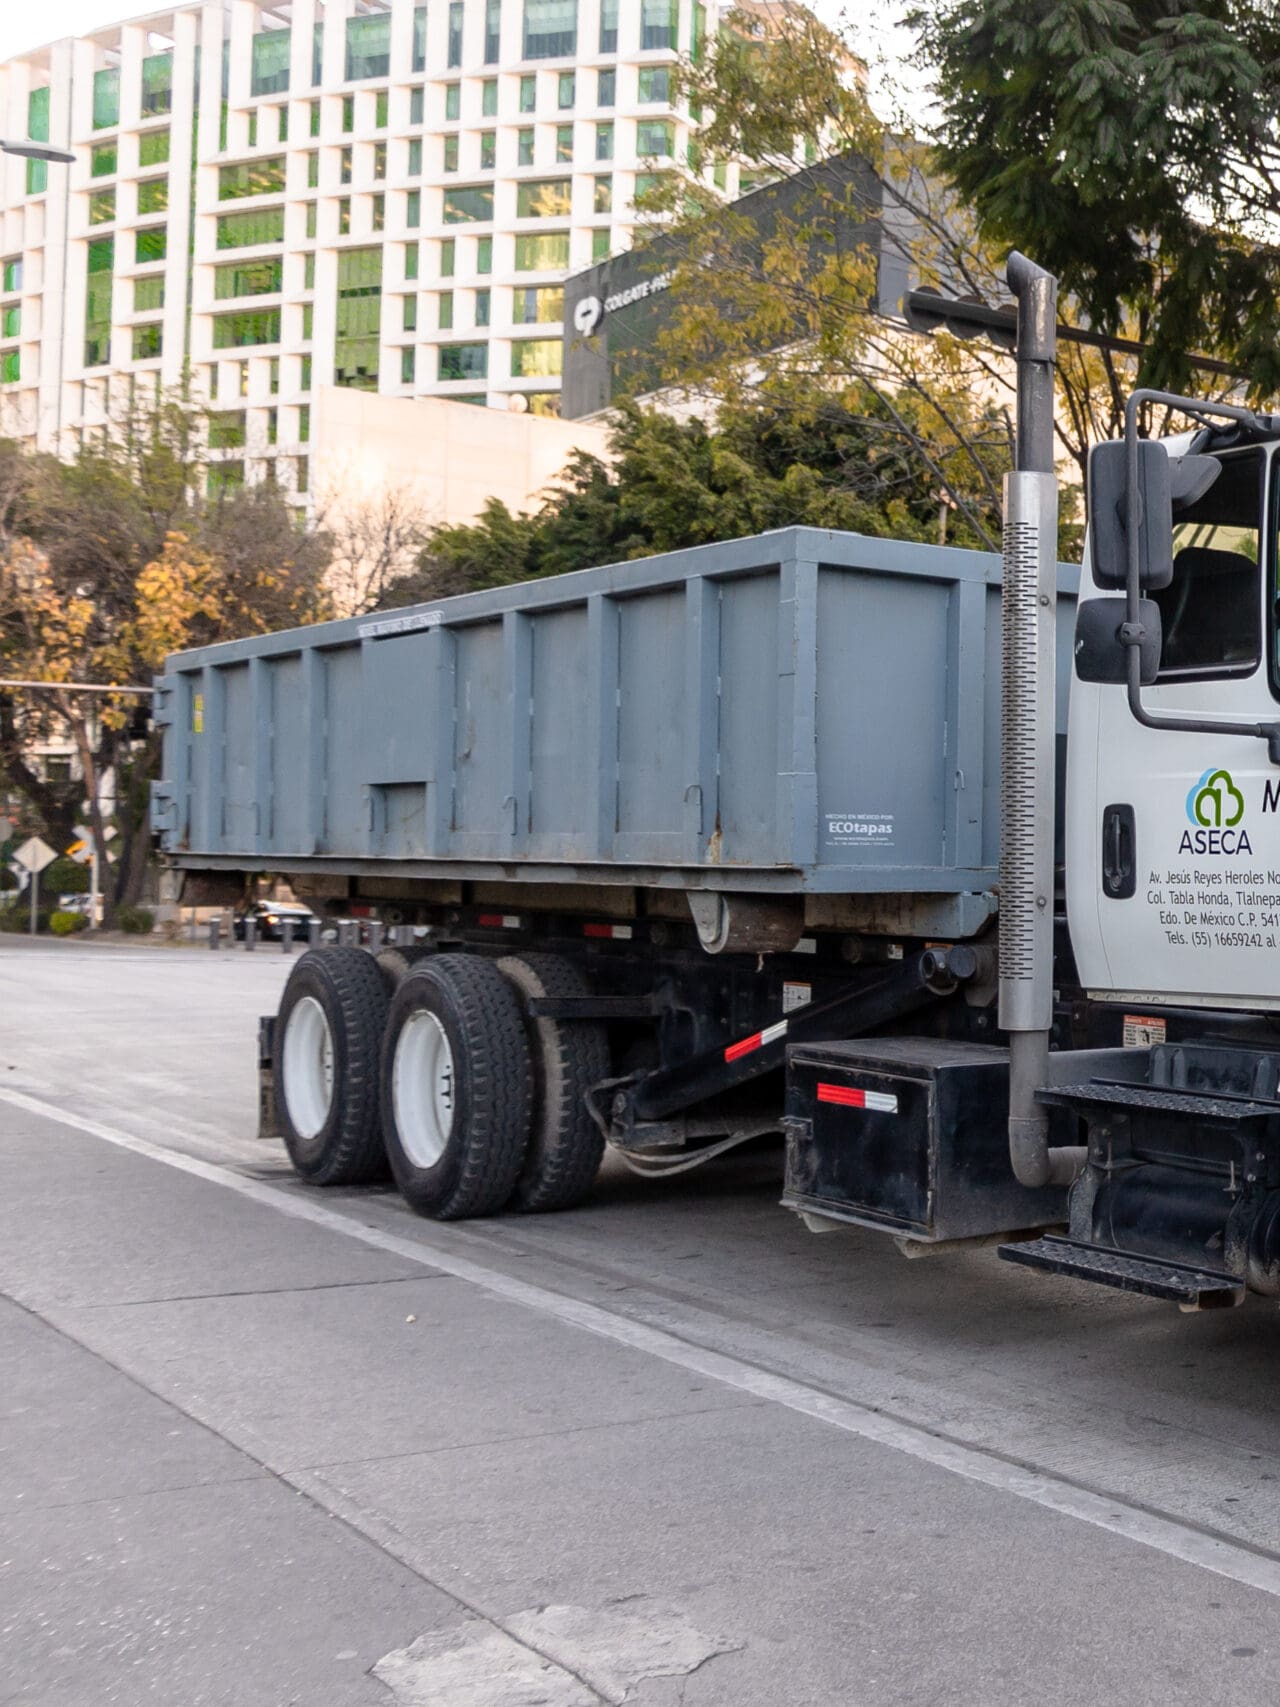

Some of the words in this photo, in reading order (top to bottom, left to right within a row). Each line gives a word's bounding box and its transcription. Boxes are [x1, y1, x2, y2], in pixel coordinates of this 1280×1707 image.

[829, 822, 893, 836] ECOtapas
[1178, 829, 1253, 855] ASECA
[1149, 870, 1162, 884] Av.
[1165, 869, 1191, 884] Jesús
[1194, 870, 1222, 887] Reyes
[1225, 870, 1264, 885] Heroles
[1147, 890, 1166, 904] Col.
[1168, 890, 1194, 905] Tabla
[1197, 890, 1233, 907] Honda,
[1160, 910, 1181, 924] Edo.
[1184, 911, 1197, 925] De
[1200, 910, 1235, 926] México
[1238, 912, 1257, 928] C.P.
[1165, 930, 1188, 945] Tels.
[1191, 931, 1211, 948] (55)
[1214, 931, 1263, 948] 16659242
[1266, 933, 1276, 948] al
